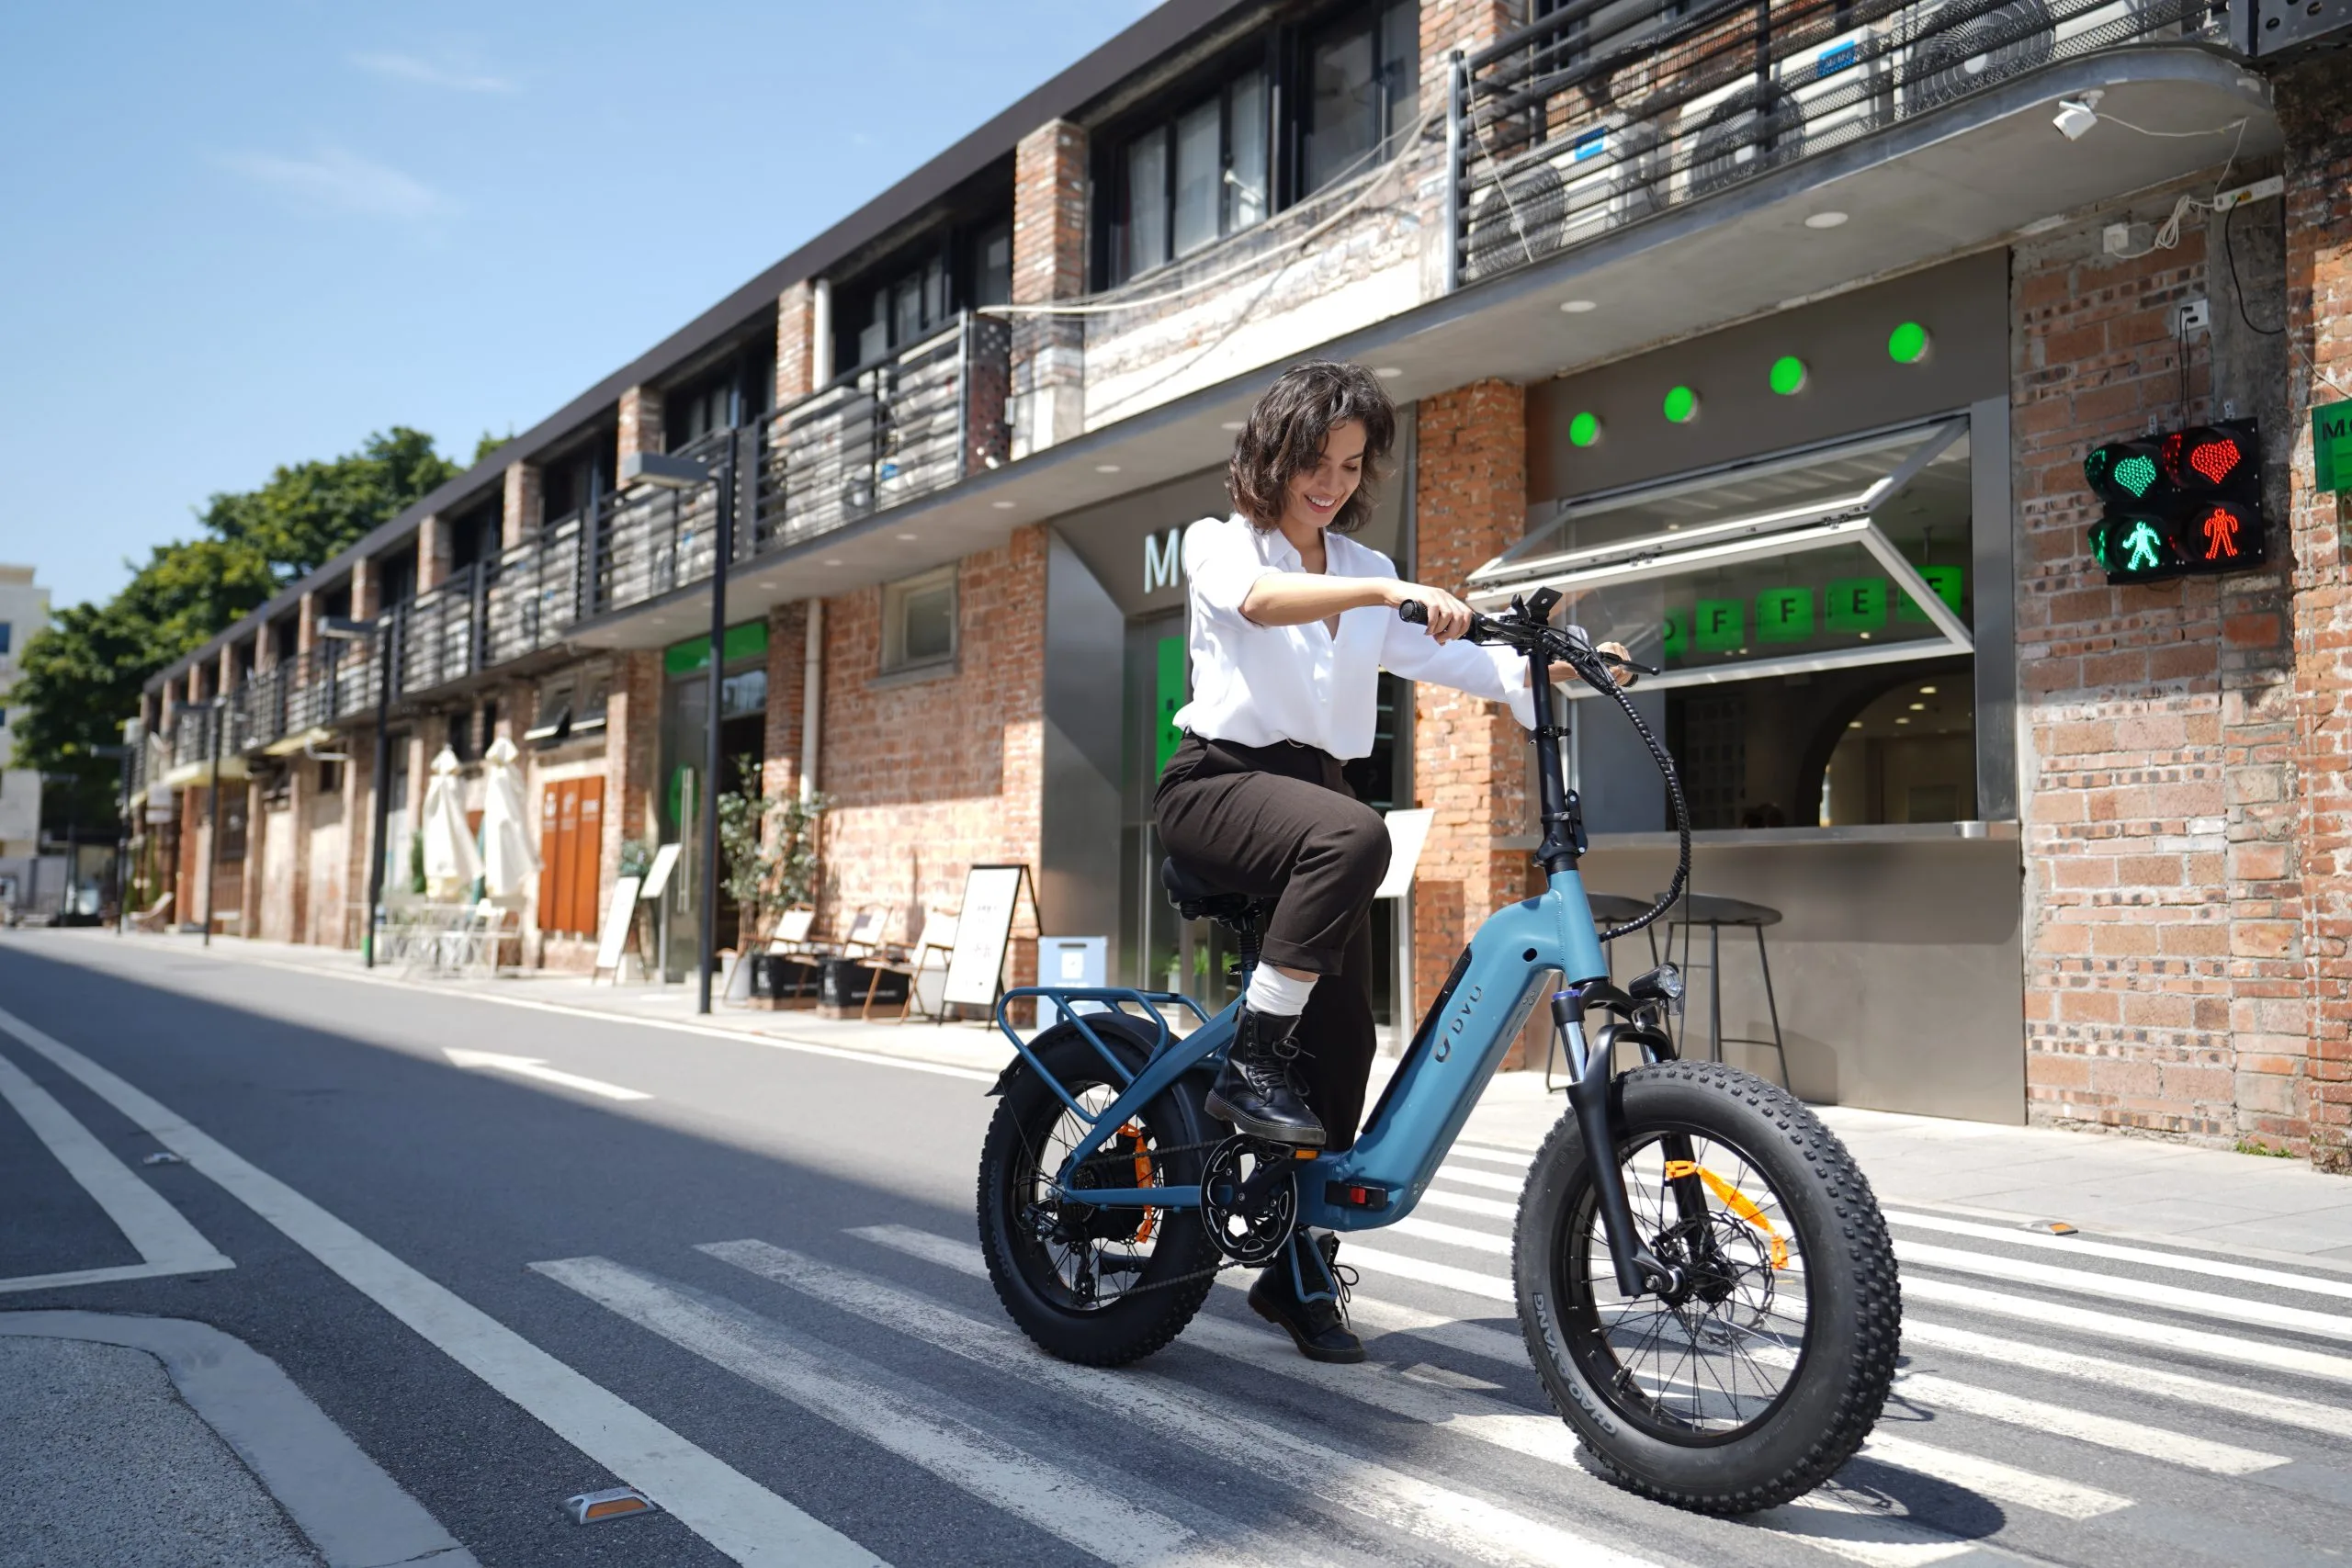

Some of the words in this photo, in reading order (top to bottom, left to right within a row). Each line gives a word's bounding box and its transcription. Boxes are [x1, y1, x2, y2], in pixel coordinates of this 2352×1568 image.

[2323, 418, 2352, 441] M
[1144, 528, 1187, 594] M
[1534, 1294, 1559, 1360] YANG
[1568, 1382, 1617, 1435] CHAO
